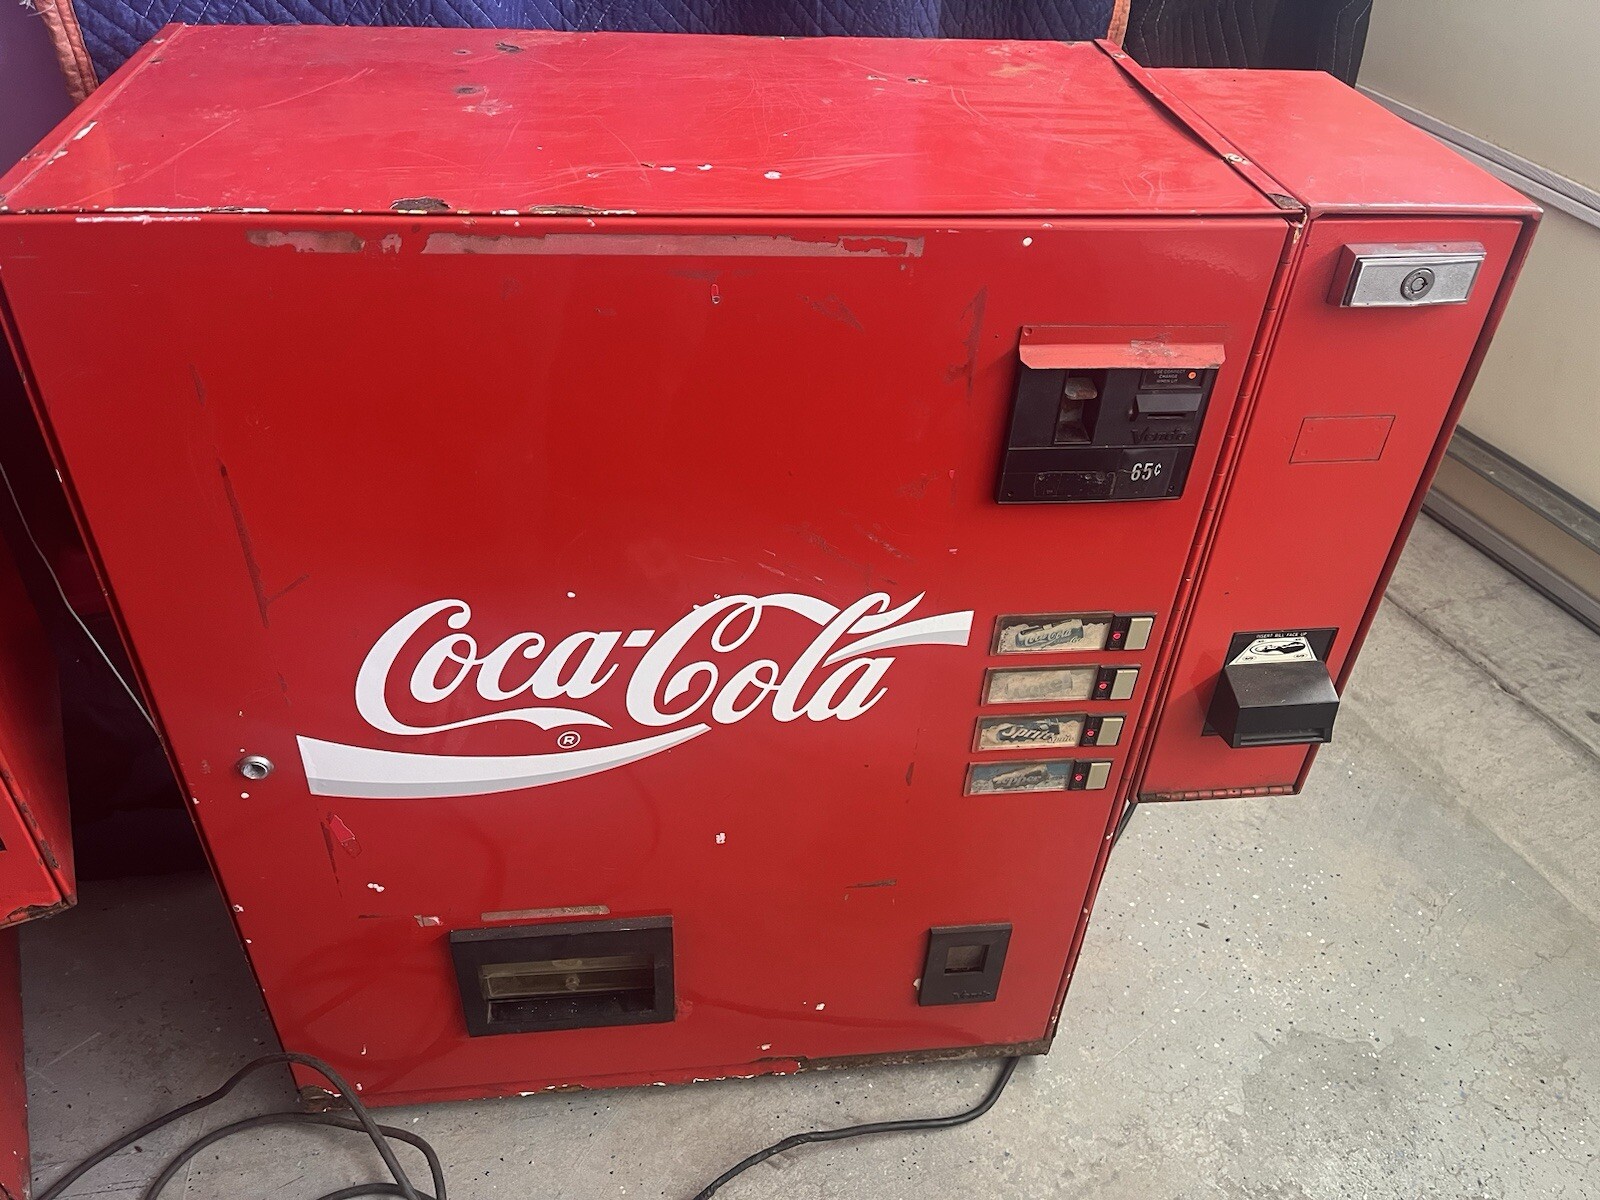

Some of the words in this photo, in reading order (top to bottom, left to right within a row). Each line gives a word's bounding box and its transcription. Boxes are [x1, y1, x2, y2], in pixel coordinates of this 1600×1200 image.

[1130, 426, 1187, 444] Vendo
[1131, 463, 1162, 481] 65¢
[355, 591, 973, 736] Coca-Cola
[1001, 724, 1054, 741] Sprite
